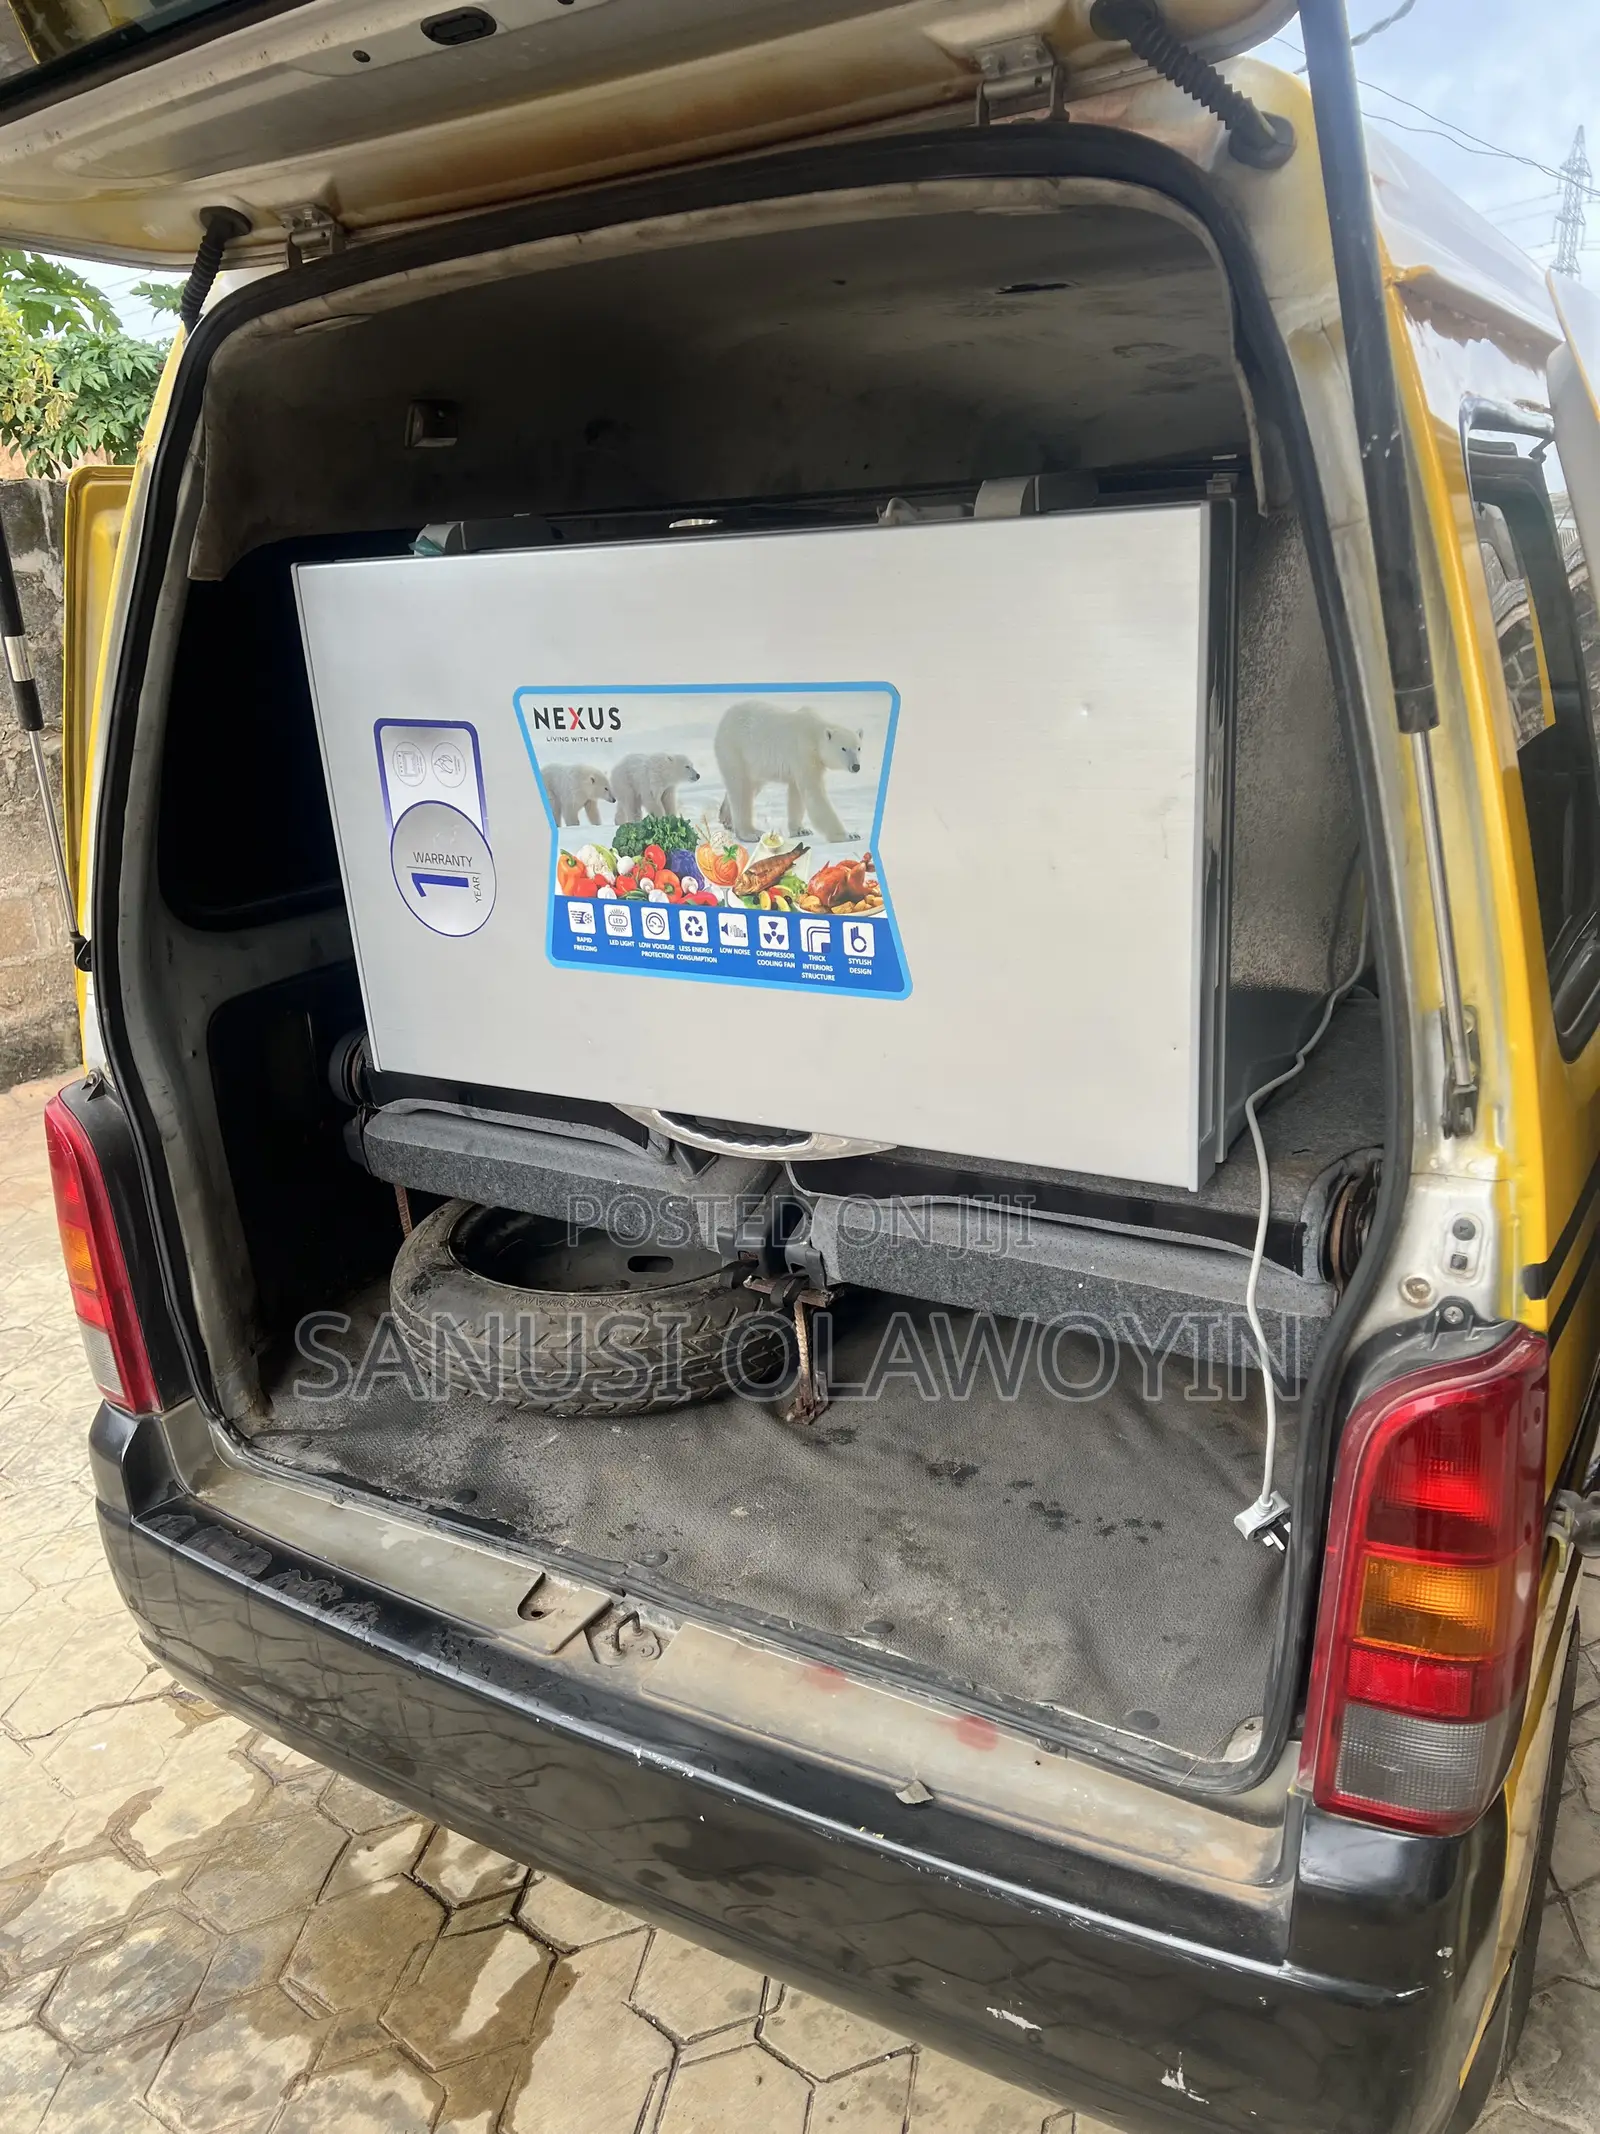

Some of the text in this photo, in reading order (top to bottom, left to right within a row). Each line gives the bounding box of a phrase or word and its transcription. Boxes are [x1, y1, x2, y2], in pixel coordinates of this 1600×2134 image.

[533, 707, 621, 730] NEXUS
[412, 851, 473, 867] WARRANTY
[411, 872, 469, 898] 1
[472, 876, 482, 903] YEAR
[573, 944, 598, 952] FREEZING
[652, 943, 675, 951] VOLTAGE
[691, 946, 713, 954] ENERGY
[641, 951, 674, 959] PROTECTION
[733, 948, 751, 956] NOISE
[756, 950, 795, 959] COMPRESSOR
[676, 953, 718, 963] CONSUMPTION
[808, 954, 826, 962] THICK
[848, 957, 872, 966] STYLISH
[757, 959, 796, 969] COOLING FAN
[802, 963, 834, 972] INTERIORS
[849, 967, 872, 976] DESIGN
[801, 972, 836, 982] STRUCTURE
[506, 1293, 614, 1309] YOKOHAMA
